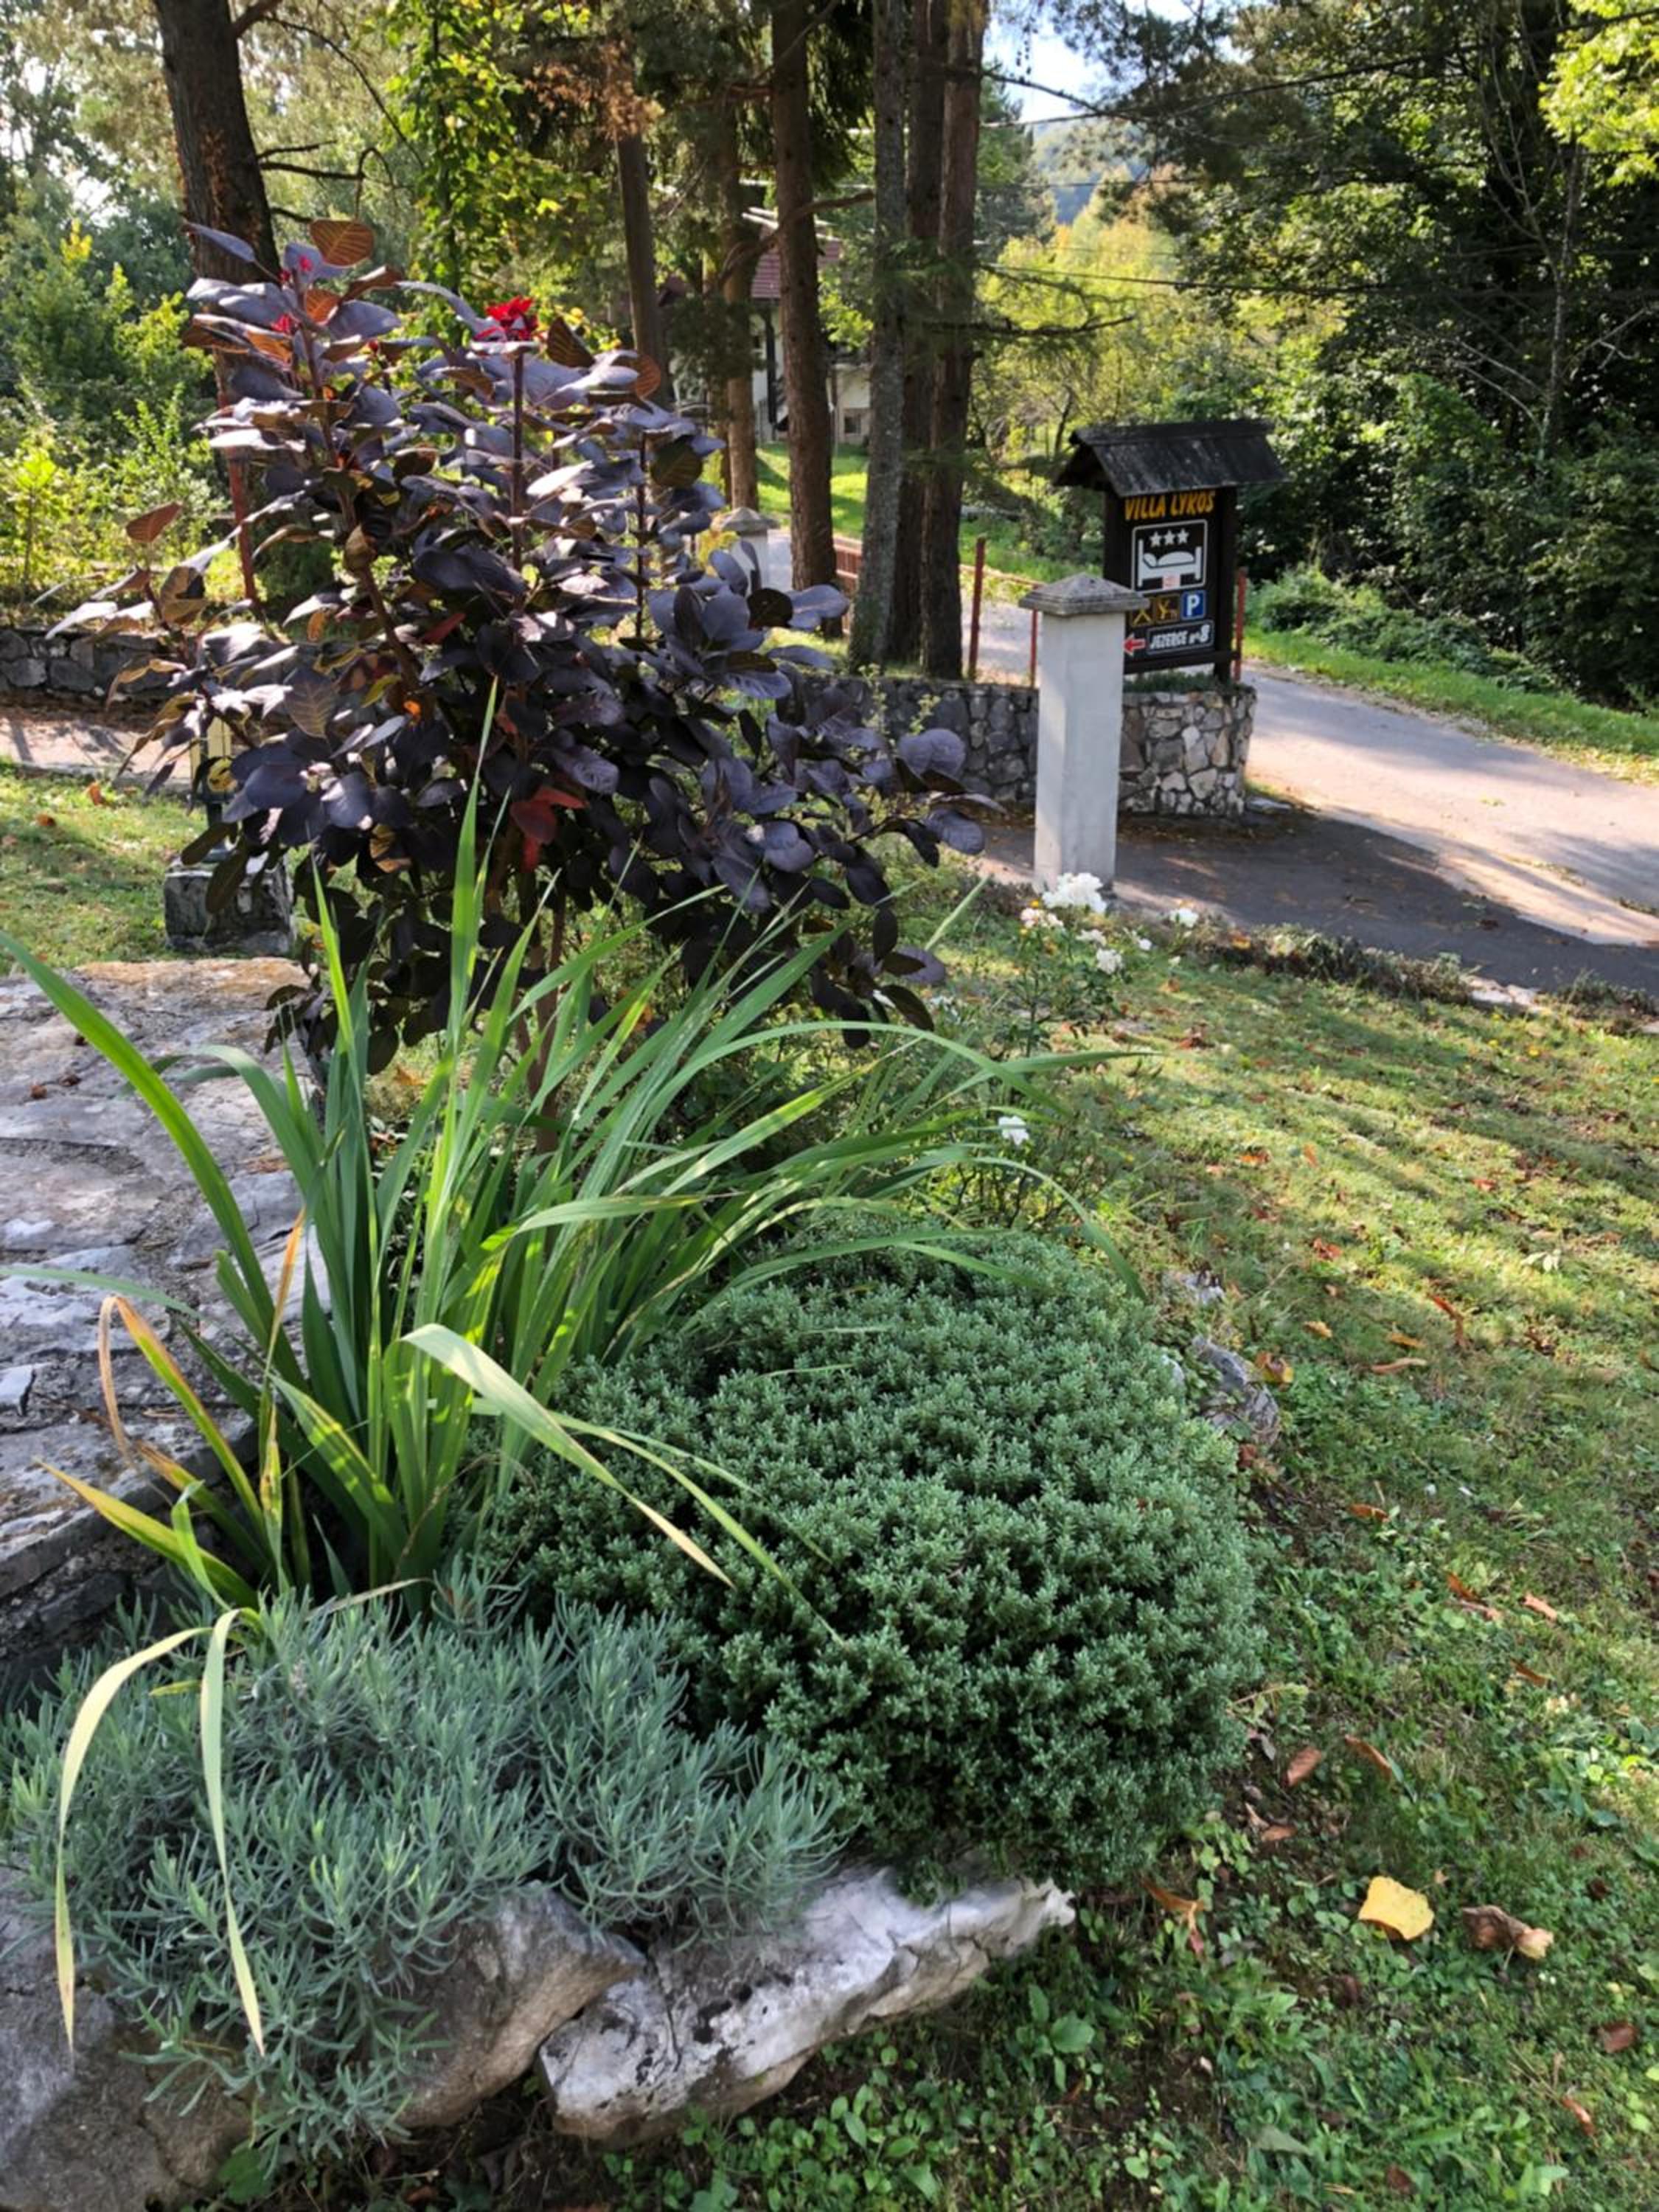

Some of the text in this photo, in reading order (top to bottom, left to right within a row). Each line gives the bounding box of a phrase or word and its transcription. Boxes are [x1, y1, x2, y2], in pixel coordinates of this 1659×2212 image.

[1125, 491, 1215, 521] VILLA LYKOS
[1186, 594, 1200, 616] P
